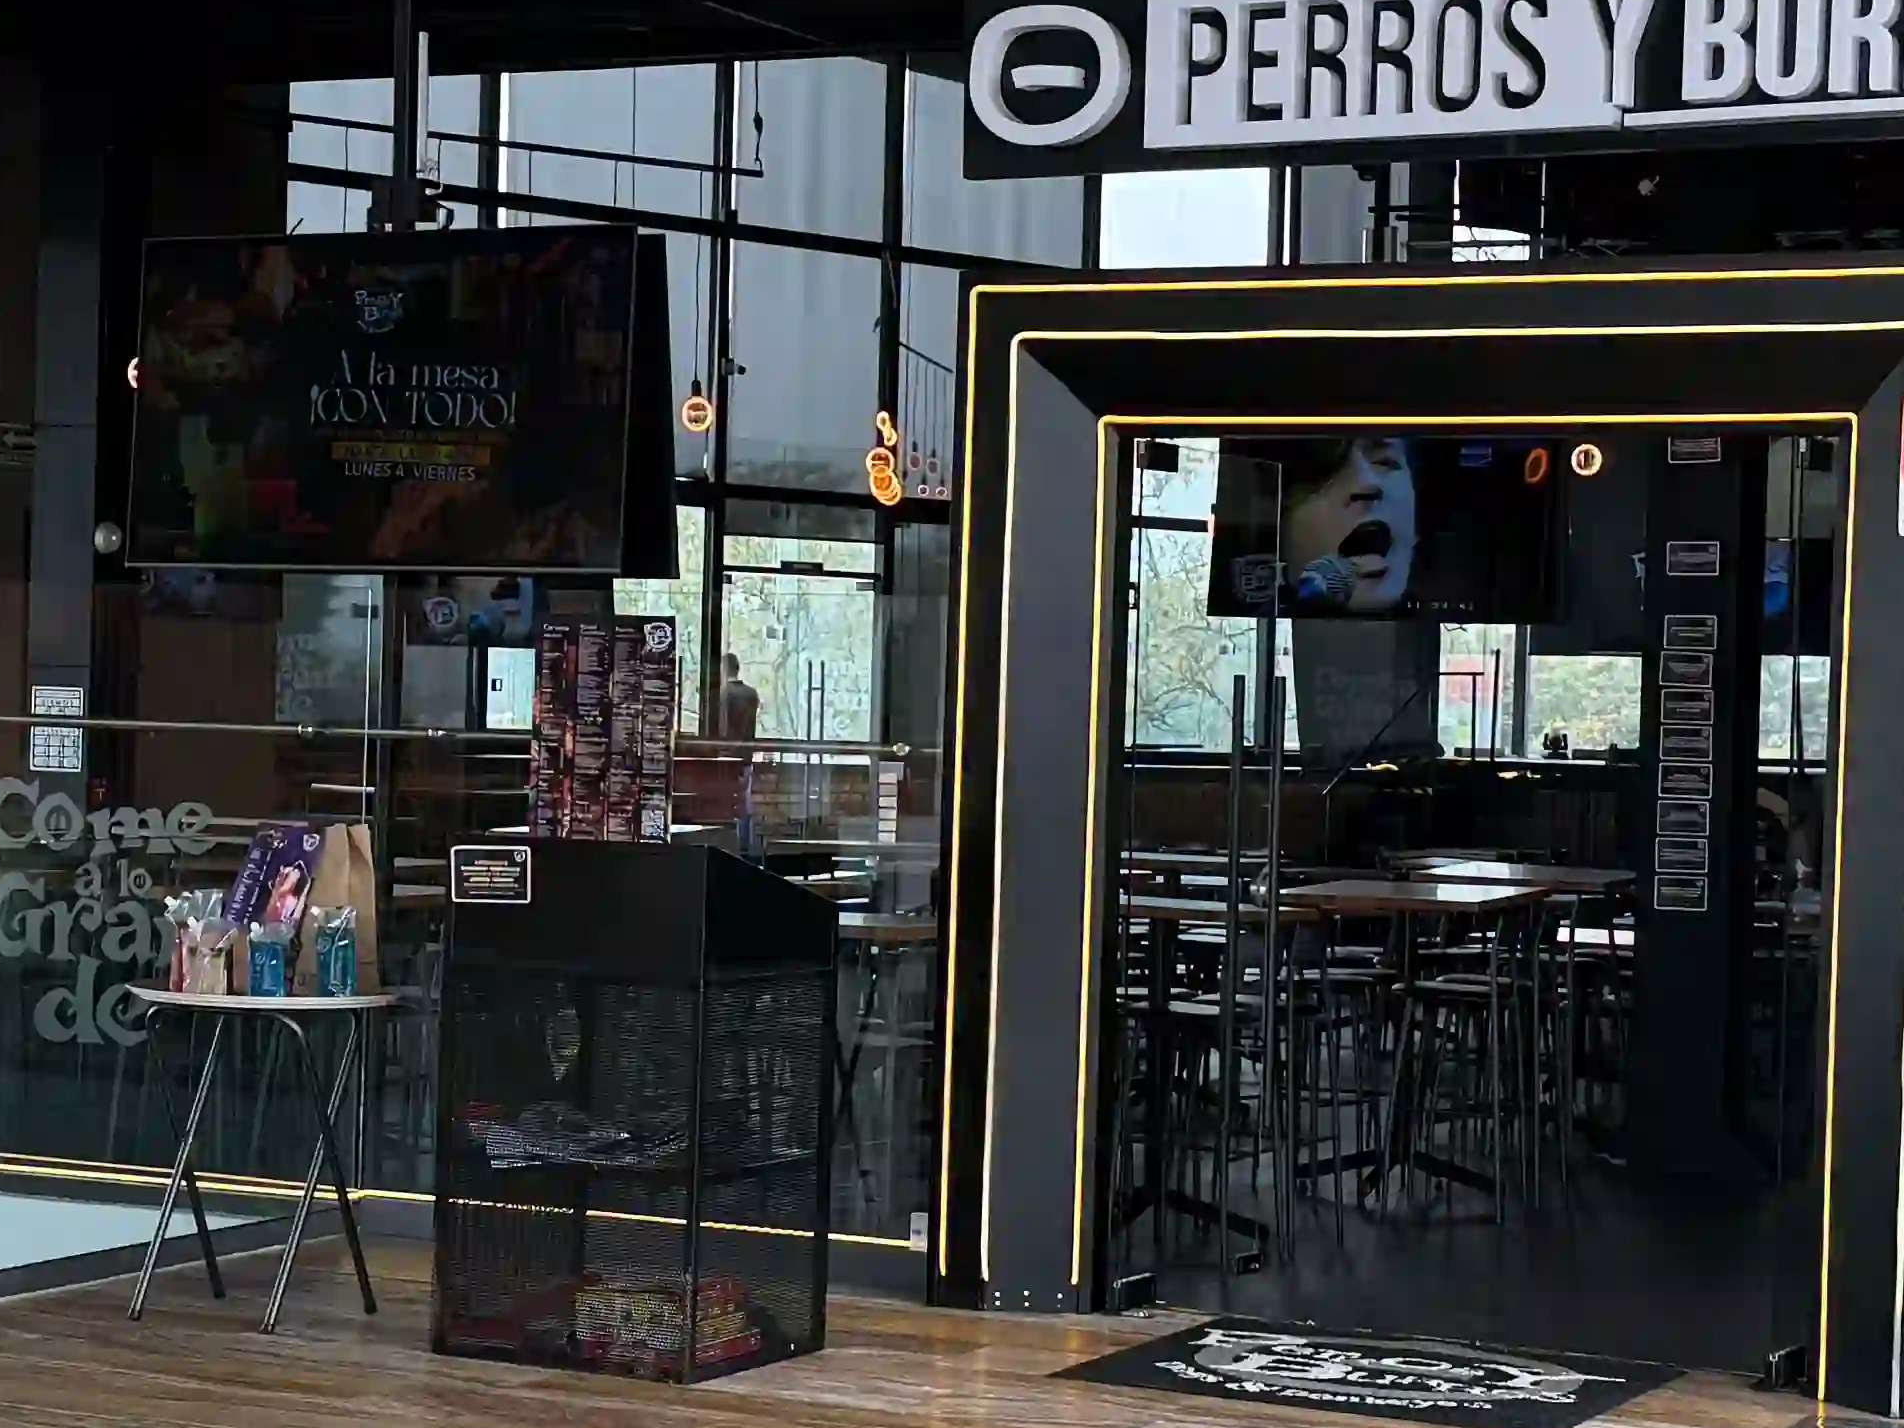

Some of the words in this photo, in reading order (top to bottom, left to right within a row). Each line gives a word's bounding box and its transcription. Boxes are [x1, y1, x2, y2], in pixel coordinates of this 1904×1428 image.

[410, 362, 500, 390] mesa
[343, 459, 394, 479] LUNES
[412, 463, 477, 482] VIERNES
[73, 860, 103, 898] a
[116, 858, 154, 899] lo
[32, 953, 150, 1048] de
